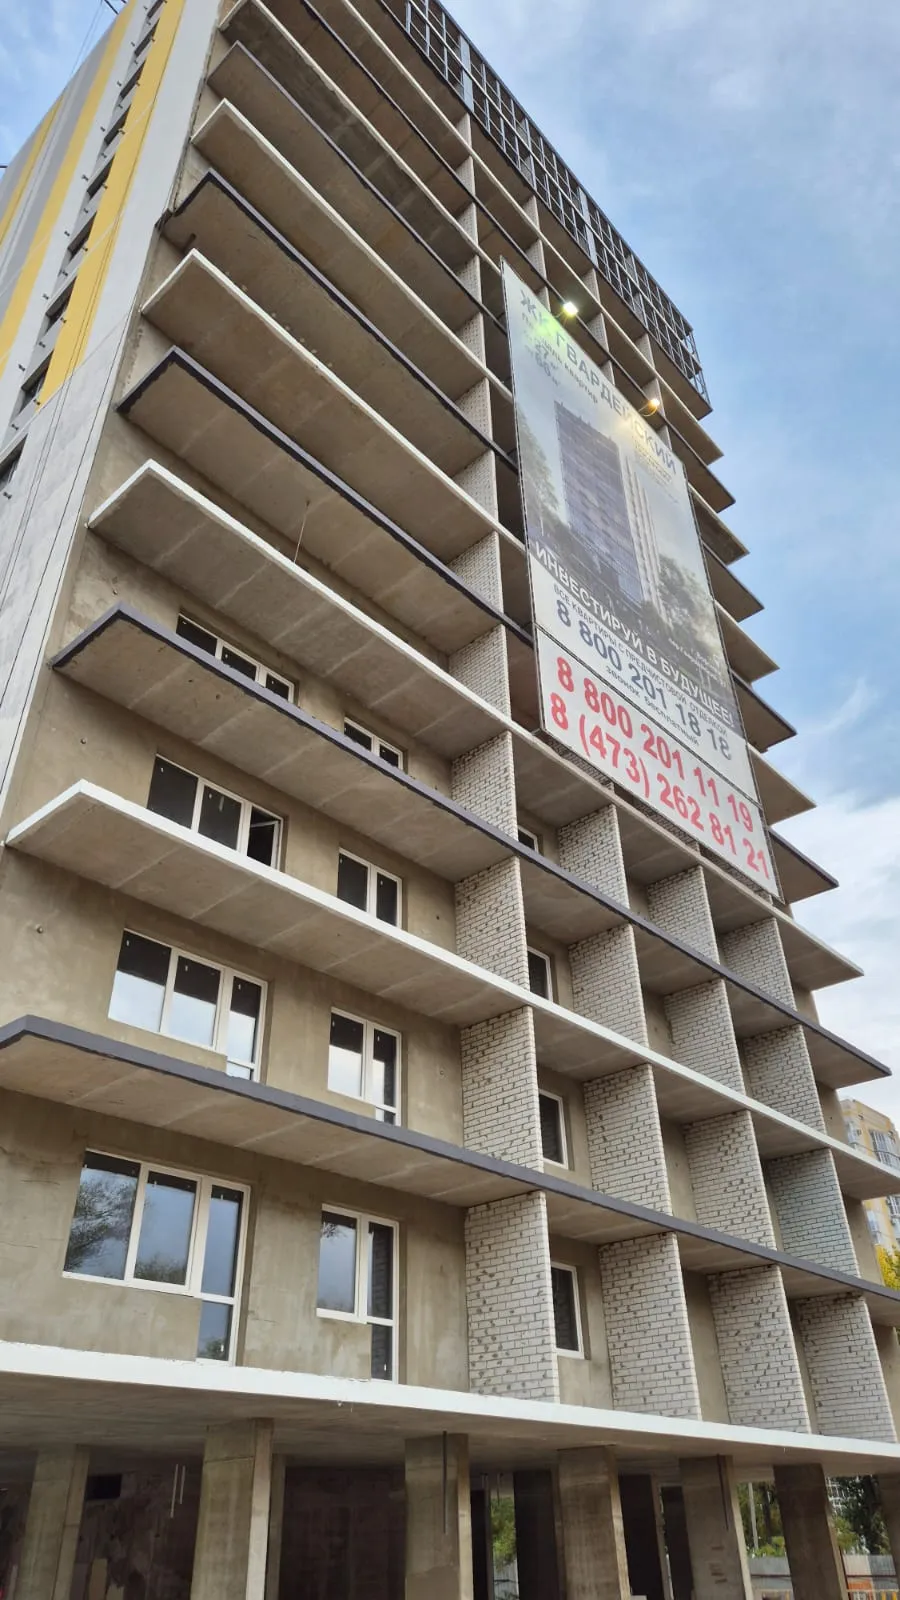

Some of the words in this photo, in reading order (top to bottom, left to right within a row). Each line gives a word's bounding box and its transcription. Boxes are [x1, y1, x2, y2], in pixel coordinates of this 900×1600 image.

[536, 541, 644, 653] ИНВЕСТИРУЙ
[646, 645, 658, 665] В
[660, 657, 735, 729] БУДУЩЕЕ!
[553, 582, 571, 606] ВСЕ
[571, 602, 617, 645] КВАРТИРЫ
[625, 646, 687, 704] ПРЕДЧИСТОВОЙ
[689, 702, 728, 737] ОТДЕЛКОЙ
[556, 599, 571, 627] 8
[579, 620, 622, 671] 800
[628, 663, 667, 710] 201
[675, 703, 701, 737] 18
[707, 728, 732, 760] 18
[606, 665, 640, 697] звонок
[644, 695, 699, 746] бесплатный
[550, 692, 569, 730] 8
[579, 714, 650, 798] (473)
[656, 772, 704, 831] 262
[709, 812, 737, 855] 81
[742, 837, 769, 880] 21
[556, 656, 574, 692] 8
[583, 677, 633, 739] 800
[640, 723, 684, 780] 201
[693, 766, 719, 807] 11
[727, 792, 753, 832] 19
